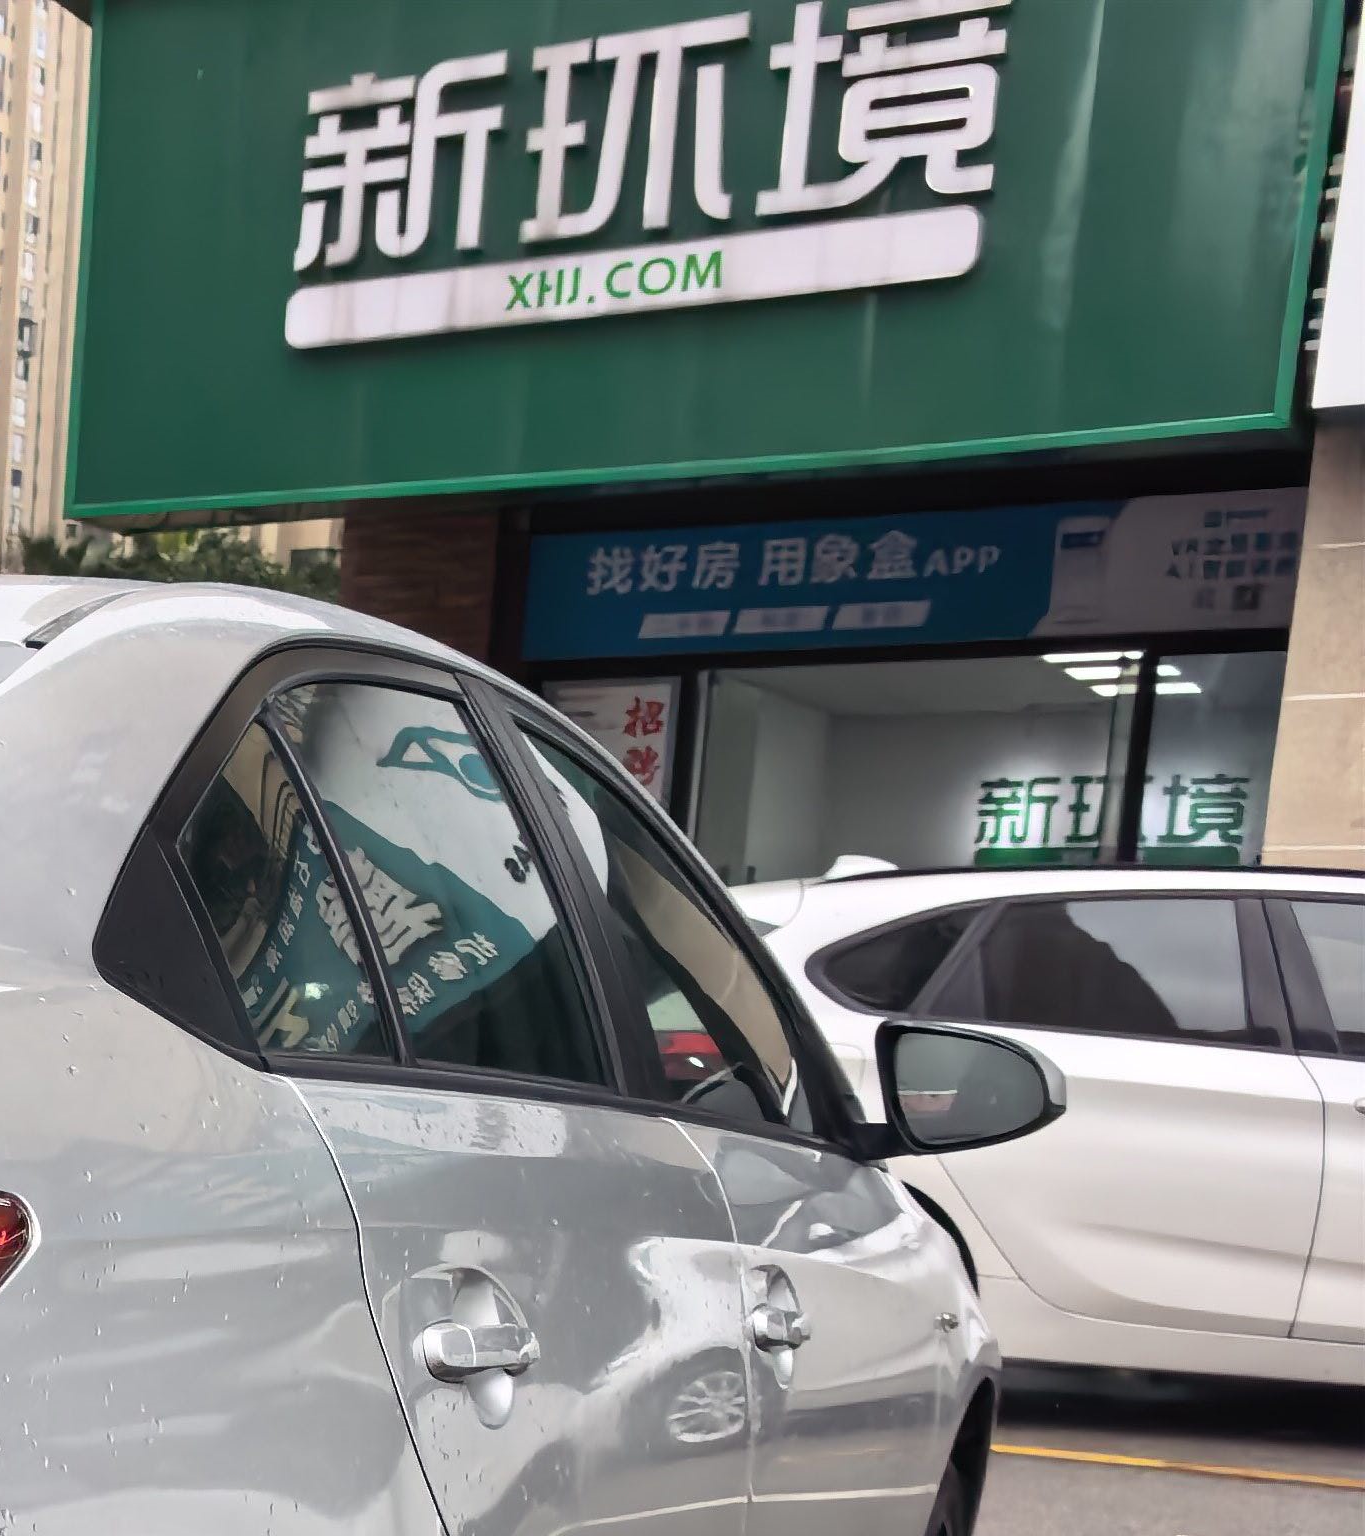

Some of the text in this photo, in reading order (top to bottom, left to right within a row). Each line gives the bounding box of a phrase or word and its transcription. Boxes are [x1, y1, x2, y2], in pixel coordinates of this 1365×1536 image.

[293, 0, 1013, 272] 新环境
[504, 249, 724, 312] XHJ.COM
[585, 540, 741, 596] 找好房
